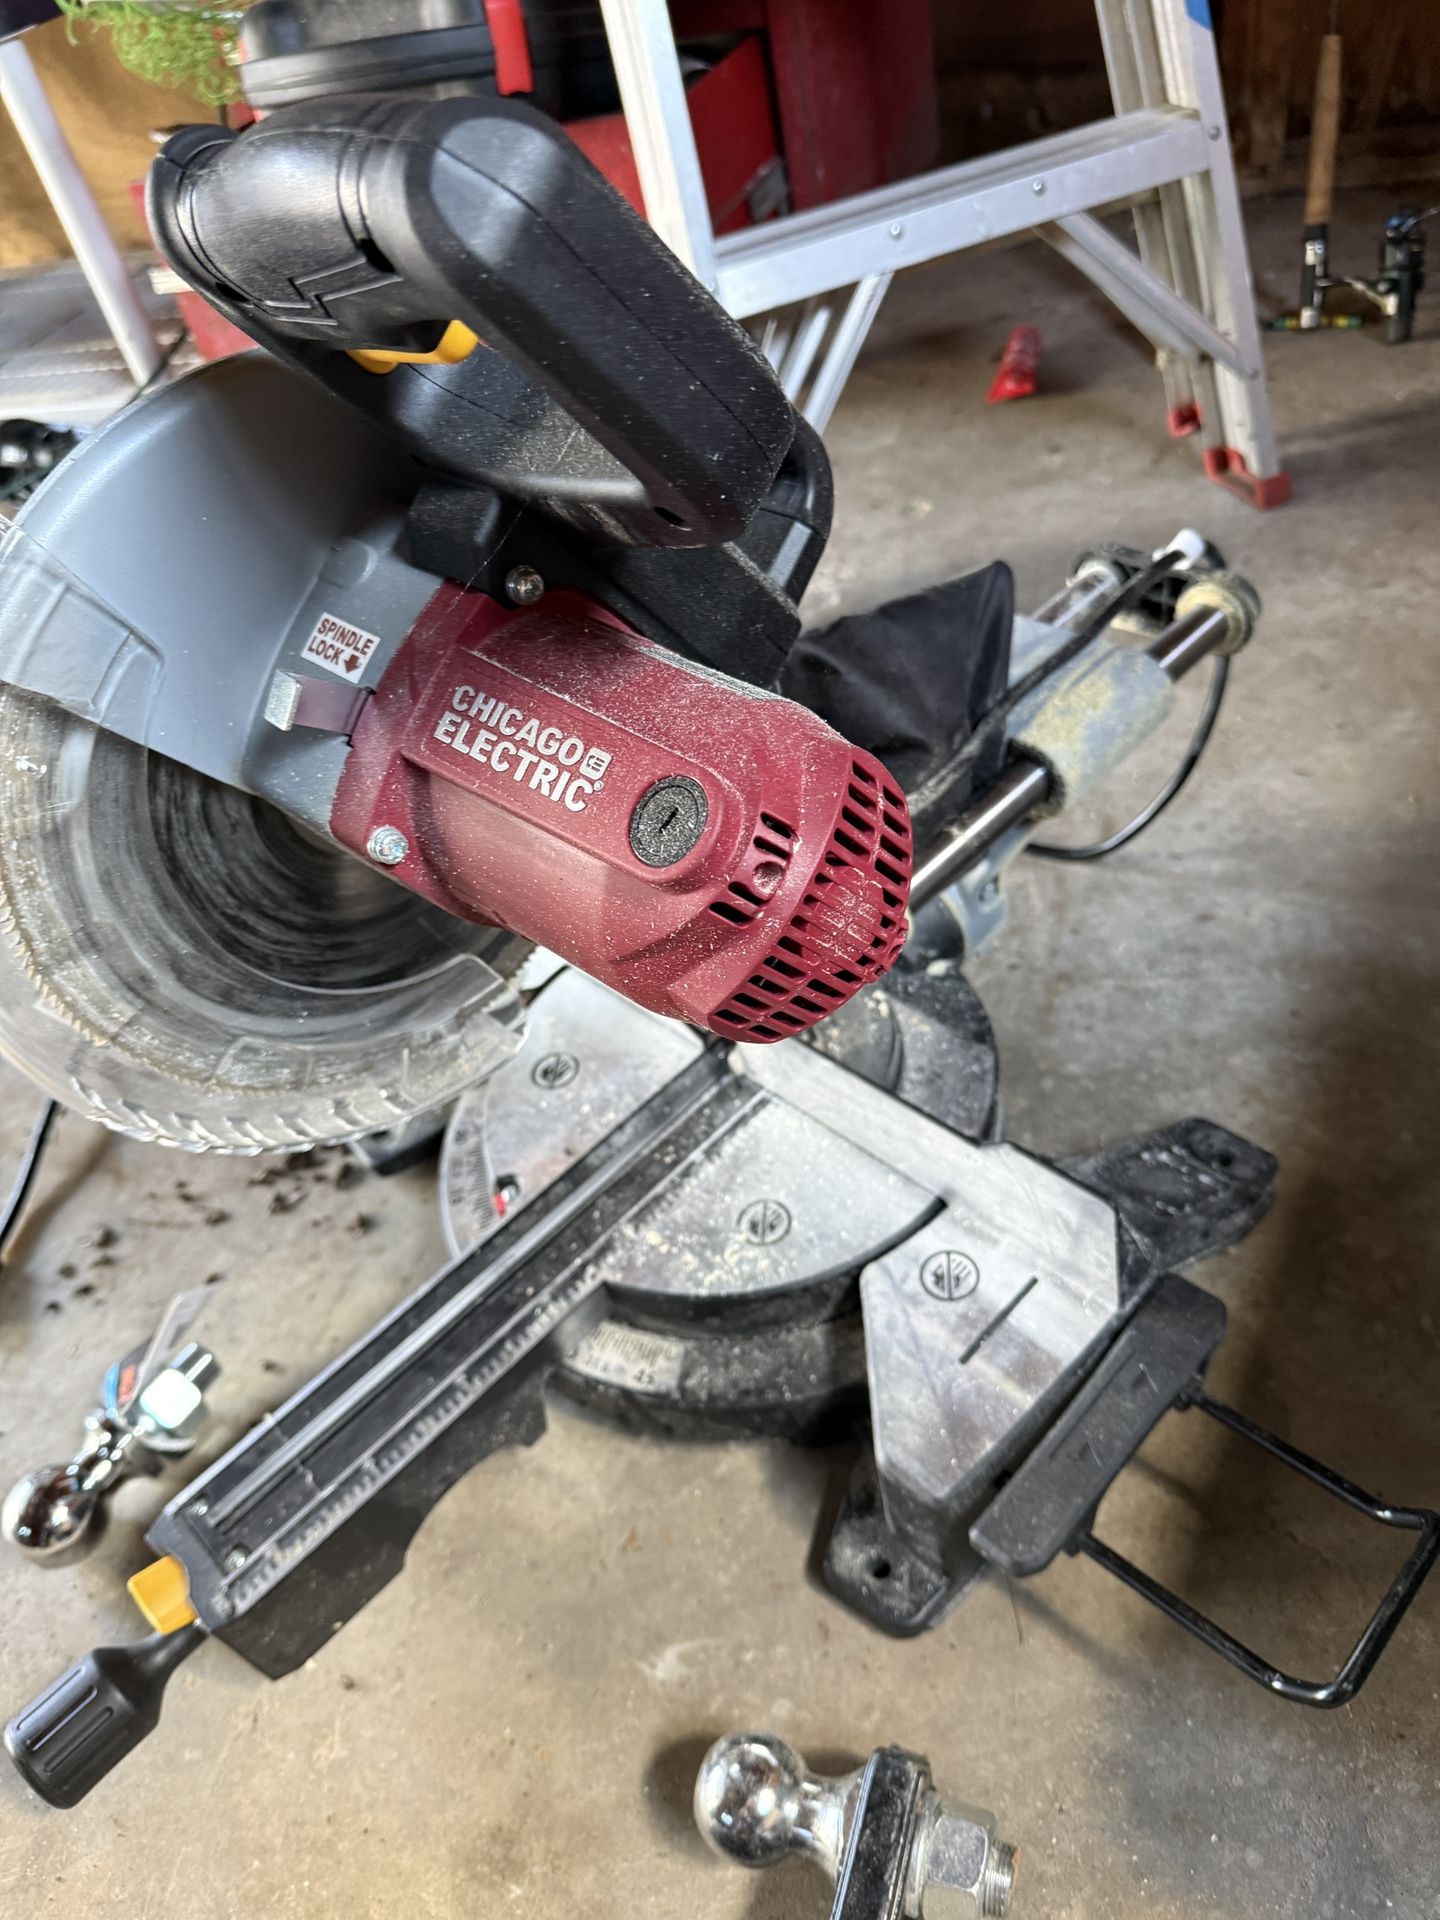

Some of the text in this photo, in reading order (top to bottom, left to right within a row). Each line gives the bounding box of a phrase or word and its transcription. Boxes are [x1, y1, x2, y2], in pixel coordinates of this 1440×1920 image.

[307, 635, 344, 665] LOCK
[318, 618, 374, 656] SPINDLE
[452, 685, 585, 766] CHICAGO
